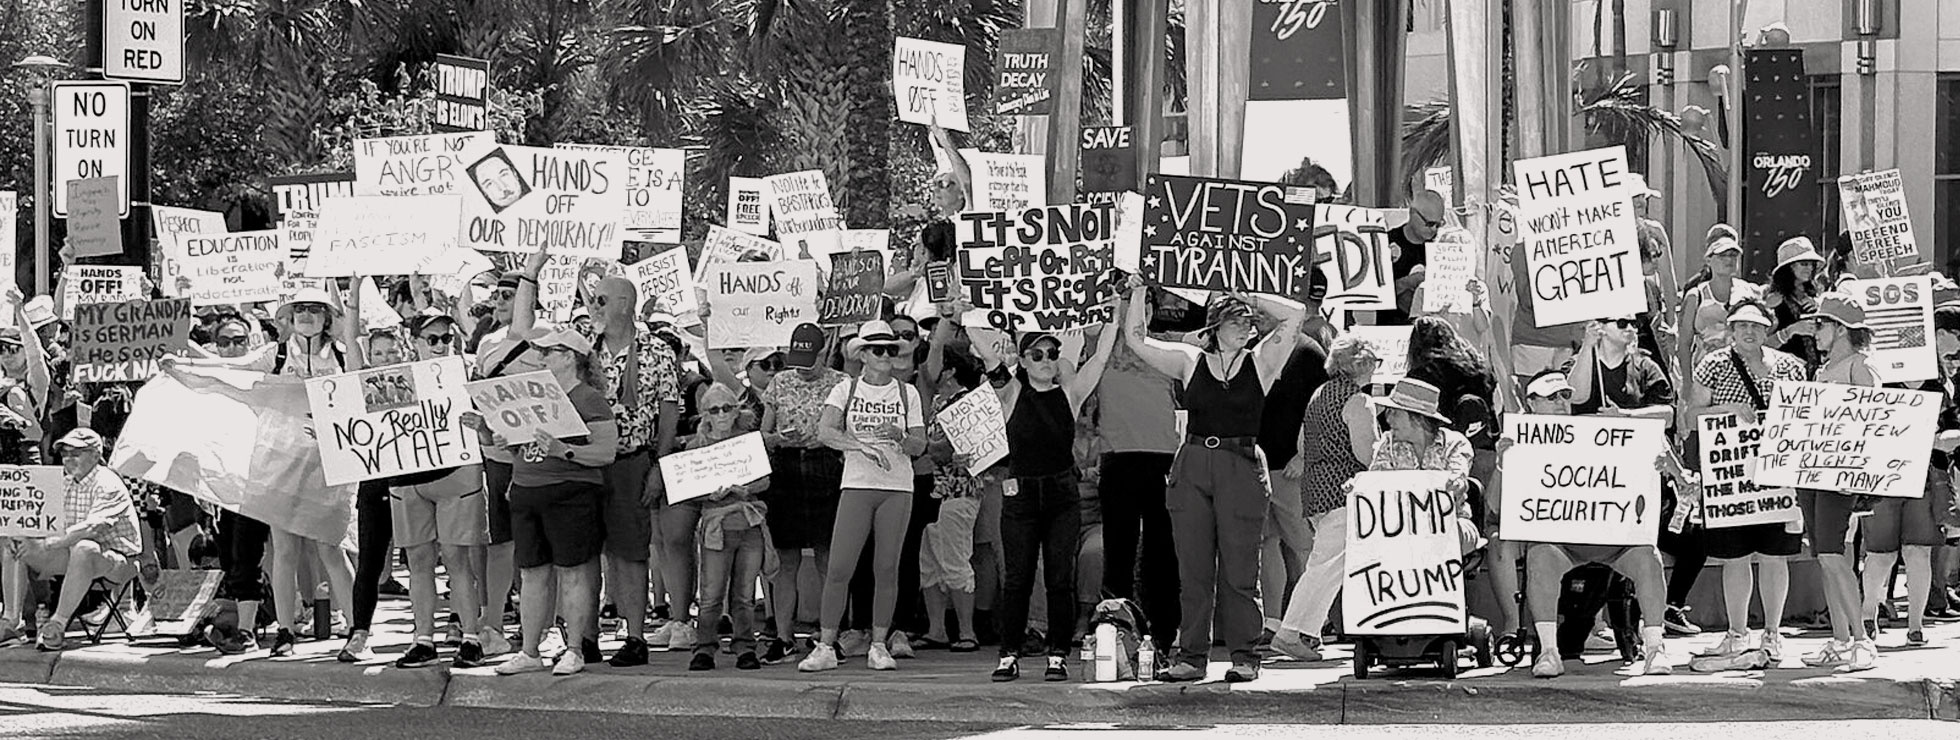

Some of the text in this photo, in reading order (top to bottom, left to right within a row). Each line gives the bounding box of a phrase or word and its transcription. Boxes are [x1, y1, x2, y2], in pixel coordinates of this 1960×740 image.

[131, 21, 155, 41] ON
[1271, 0, 1327, 40] 150
[124, 49, 162, 69] RED
[898, 47, 943, 83] HANDS
[1003, 53, 1049, 69] TRUTH
[438, 63, 487, 99] TRUMP
[1001, 72, 1046, 88] DECAY
[74, 92, 106, 116] NO
[437, 100, 450, 125] IS
[66, 129, 115, 148] TURN
[363, 141, 379, 157] IF
[443, 135, 475, 152] NOT
[1082, 127, 1132, 149] SAVE
[78, 160, 103, 178] ON
[378, 155, 464, 187] ANGR
[1753, 154, 1811, 168] ORLANDO
[532, 152, 609, 195] HANDS
[666, 170, 683, 192] A
[1525, 157, 1622, 200] HATE
[1761, 166, 1803, 198] 150
[1854, 178, 1901, 193] MAHMOUD
[546, 194, 580, 215] OFF
[625, 188, 650, 207] TO
[737, 203, 760, 214] FREE
[1164, 181, 1288, 239] VETS
[1577, 201, 1622, 227] MAKE
[1876, 205, 1902, 220] YOU
[469, 216, 507, 247] OUR
[1047, 202, 1116, 246] NOT
[1854, 222, 1909, 242] DEFEND
[187, 233, 279, 258] EDUCATION
[1170, 231, 1271, 252] AGAINST
[1533, 228, 1615, 262] AMERICA
[1866, 234, 1901, 250] FREE
[1860, 243, 1914, 263] SPEECH
[80, 268, 123, 279] HANDS
[637, 253, 678, 279] RESIST
[1150, 245, 1303, 296] TYRANNY
[1535, 250, 1629, 302] GREAT
[80, 278, 123, 295] OFF!
[546, 282, 574, 295] STOP
[719, 269, 785, 295] HANDS
[1865, 282, 1920, 307] SOS
[75, 300, 191, 326] MY GRANDPA
[765, 305, 800, 325] Rights
[95, 321, 174, 343] GERMAN
[88, 347, 114, 363] He
[73, 359, 161, 383] FUCK NA
[474, 379, 564, 412] HANDS
[1779, 386, 1925, 408] WHY SHOULD
[333, 396, 452, 451] NO Really
[501, 403, 560, 429] OFF!
[1704, 414, 1738, 431] THE
[1823, 406, 1896, 422] WANTS
[1516, 422, 1636, 447] HANDS OFF
[1714, 431, 1727, 446] A
[1768, 423, 1791, 440] OF
[1806, 422, 1846, 438] THE
[1862, 423, 1912, 438] FEW
[1776, 438, 1867, 454] OUTWEIGH
[1711, 464, 1745, 481] THE
[1760, 452, 1912, 472] THE RIGHTS OF
[1540, 463, 1626, 488] SOCIAL
[1795, 469, 1902, 493] THE MANY?
[25, 485, 45, 500] TO
[1704, 482, 1735, 498] THE
[1, 499, 45, 516] REPAY
[1355, 488, 1455, 541] DUMP
[1519, 494, 1647, 525] SECURITY!
[1706, 495, 1794, 519] THOSE WHO
[1349, 558, 1464, 606] TRUMP
